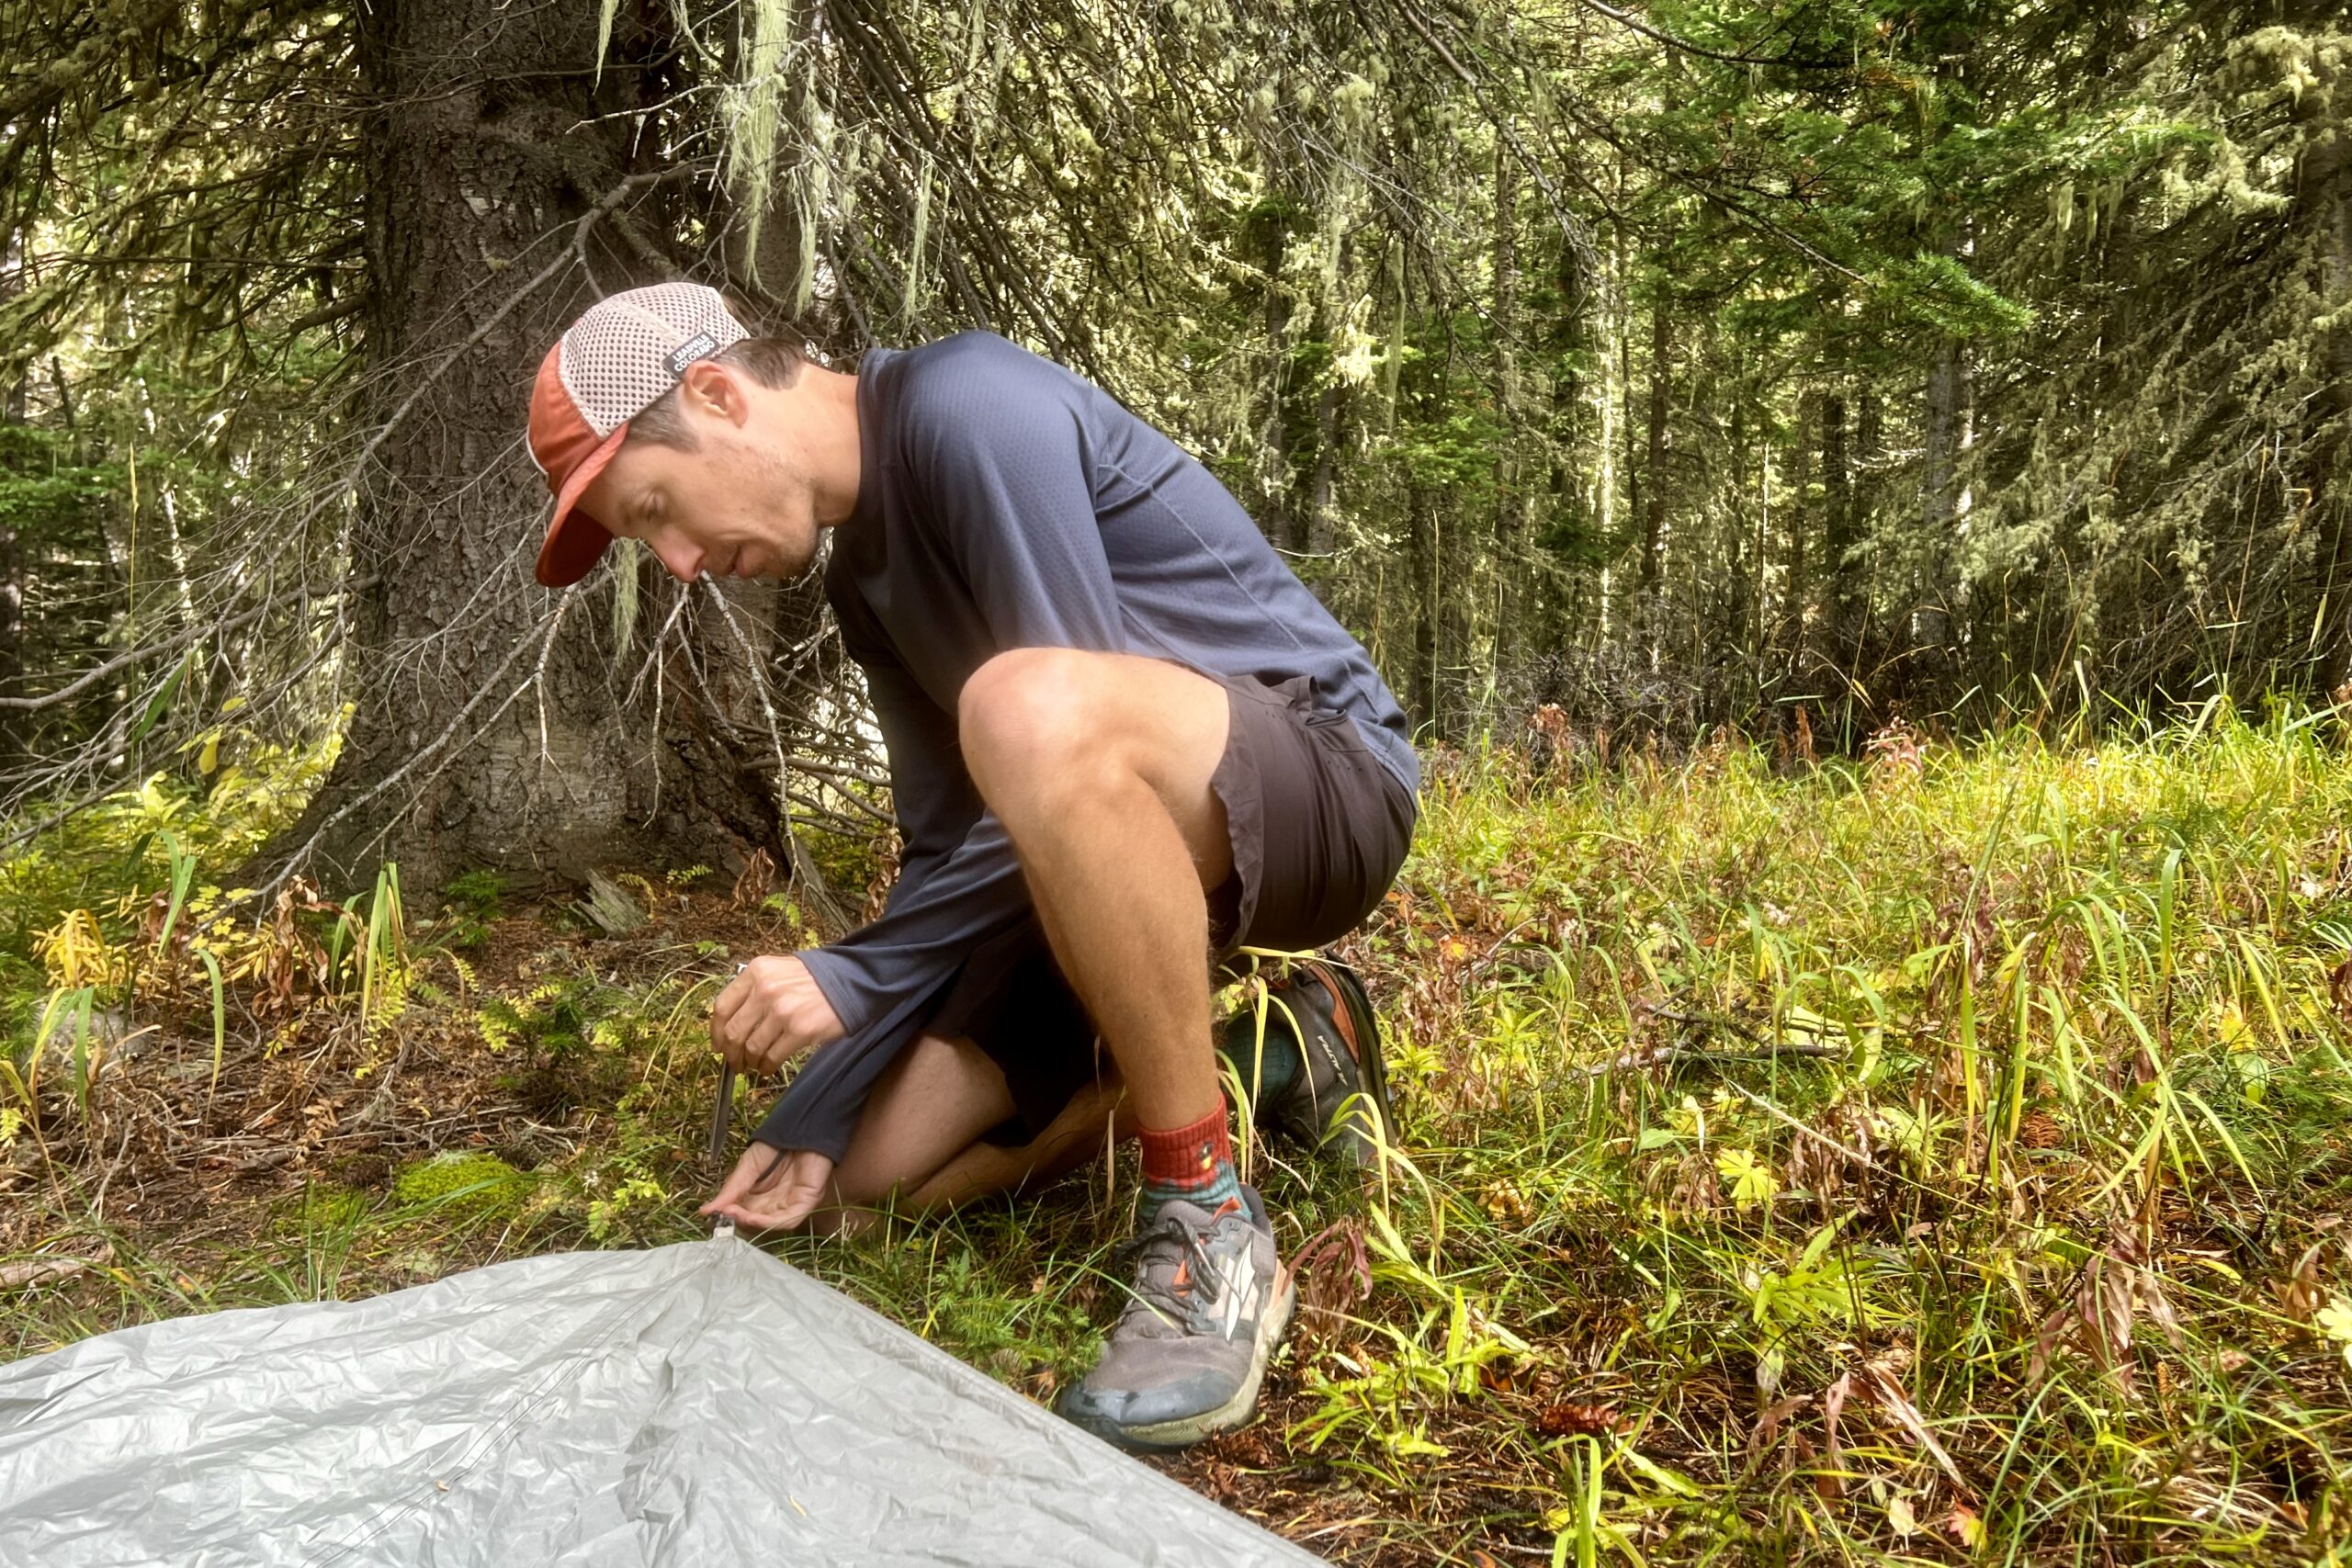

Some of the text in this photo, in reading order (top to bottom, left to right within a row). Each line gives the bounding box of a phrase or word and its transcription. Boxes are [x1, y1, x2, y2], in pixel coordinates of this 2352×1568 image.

[673, 334, 709, 361] LEADVILLE
[673, 341, 715, 371] COLORADO
[1317, 1035, 1341, 1070] ALTRA
